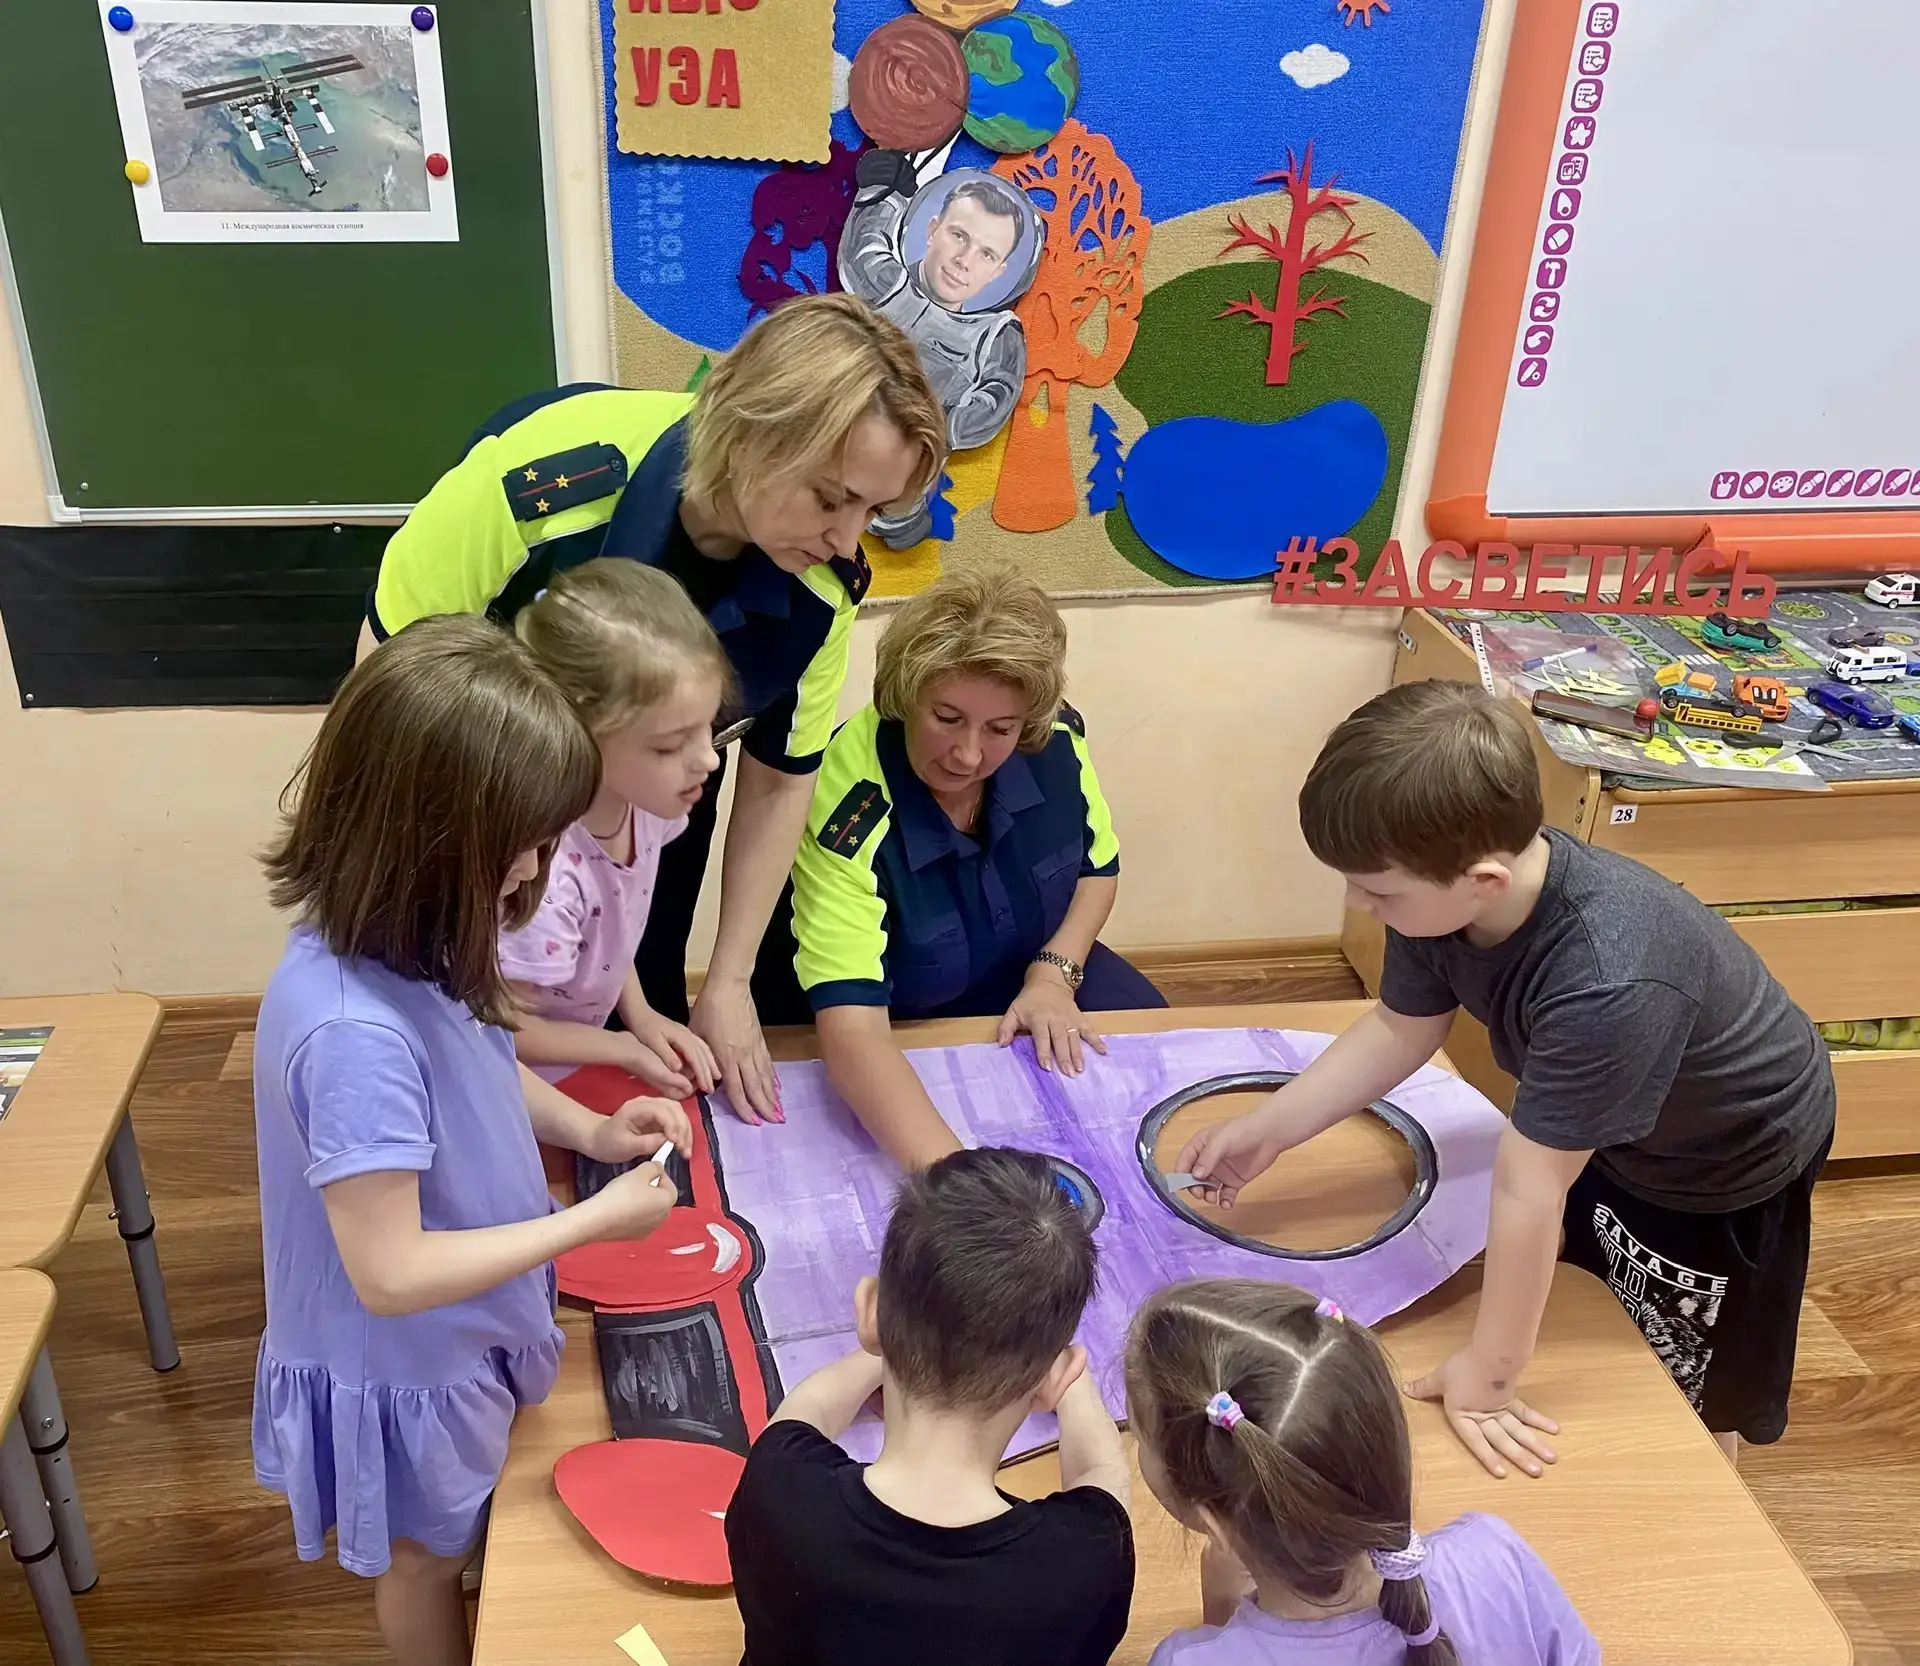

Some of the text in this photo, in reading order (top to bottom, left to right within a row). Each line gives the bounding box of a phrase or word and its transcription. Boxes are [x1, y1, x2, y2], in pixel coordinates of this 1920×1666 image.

[631, 46, 741, 109] УЭА
[221, 222, 364, 231] 11. Международная космическая станция
[1272, 535, 1777, 617] #ЗАСВЕТИСЬ
[1614, 808, 1633, 822] 28
[1593, 1207, 1728, 1293] SAVAGE
